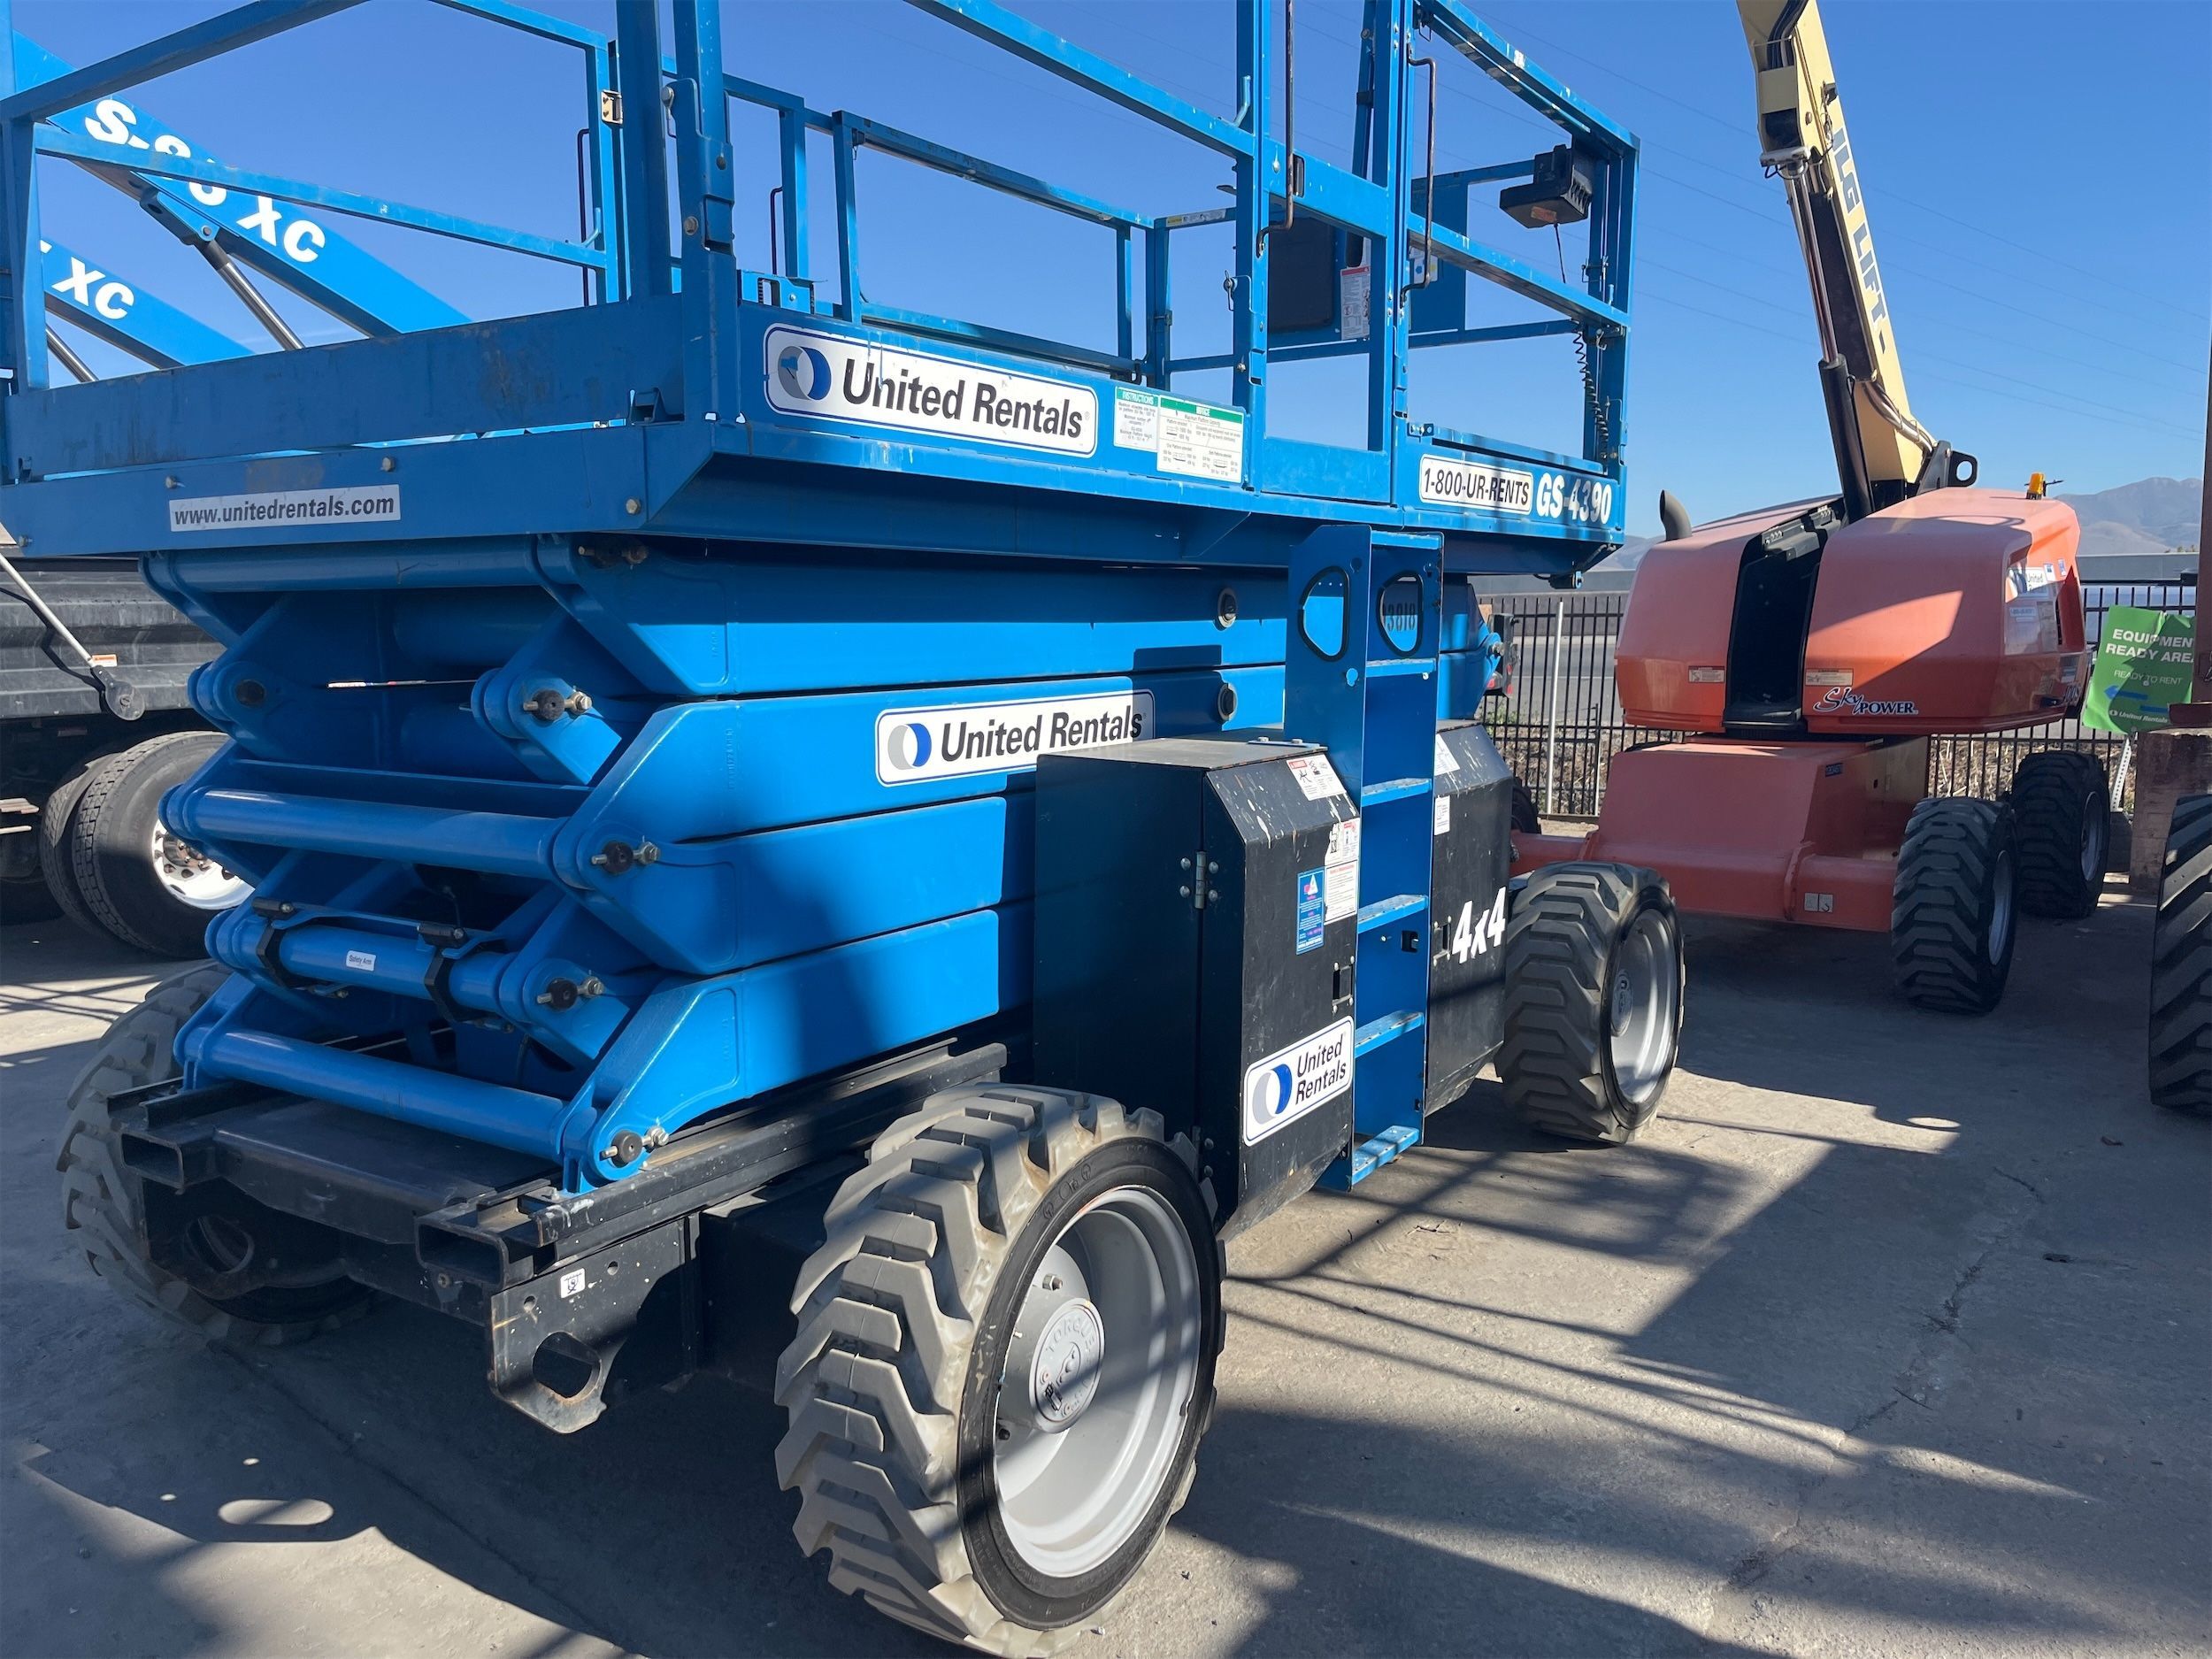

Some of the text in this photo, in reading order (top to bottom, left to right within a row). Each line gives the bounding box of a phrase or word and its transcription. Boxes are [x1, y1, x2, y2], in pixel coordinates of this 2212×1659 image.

[236, 196, 326, 263] XC
[51, 257, 134, 319] XC
[1853, 222, 1886, 324] LIFT
[842, 357, 965, 418] United
[972, 383, 1083, 440] Rentals
[174, 495, 395, 525] www.unitedrentals.com
[1423, 467, 1612, 525] 1-800-UR-RENTS GS-4390
[2106, 643, 2158, 660] READY
[2112, 628, 2195, 649] EQUIPMEN
[2114, 669, 2183, 685] READY TO RENT
[941, 705, 1143, 763] United Rentals
[1452, 886, 1506, 964] 4x4
[1295, 1059, 1347, 1106] Rentals
[1296, 1033, 1344, 1078] United
